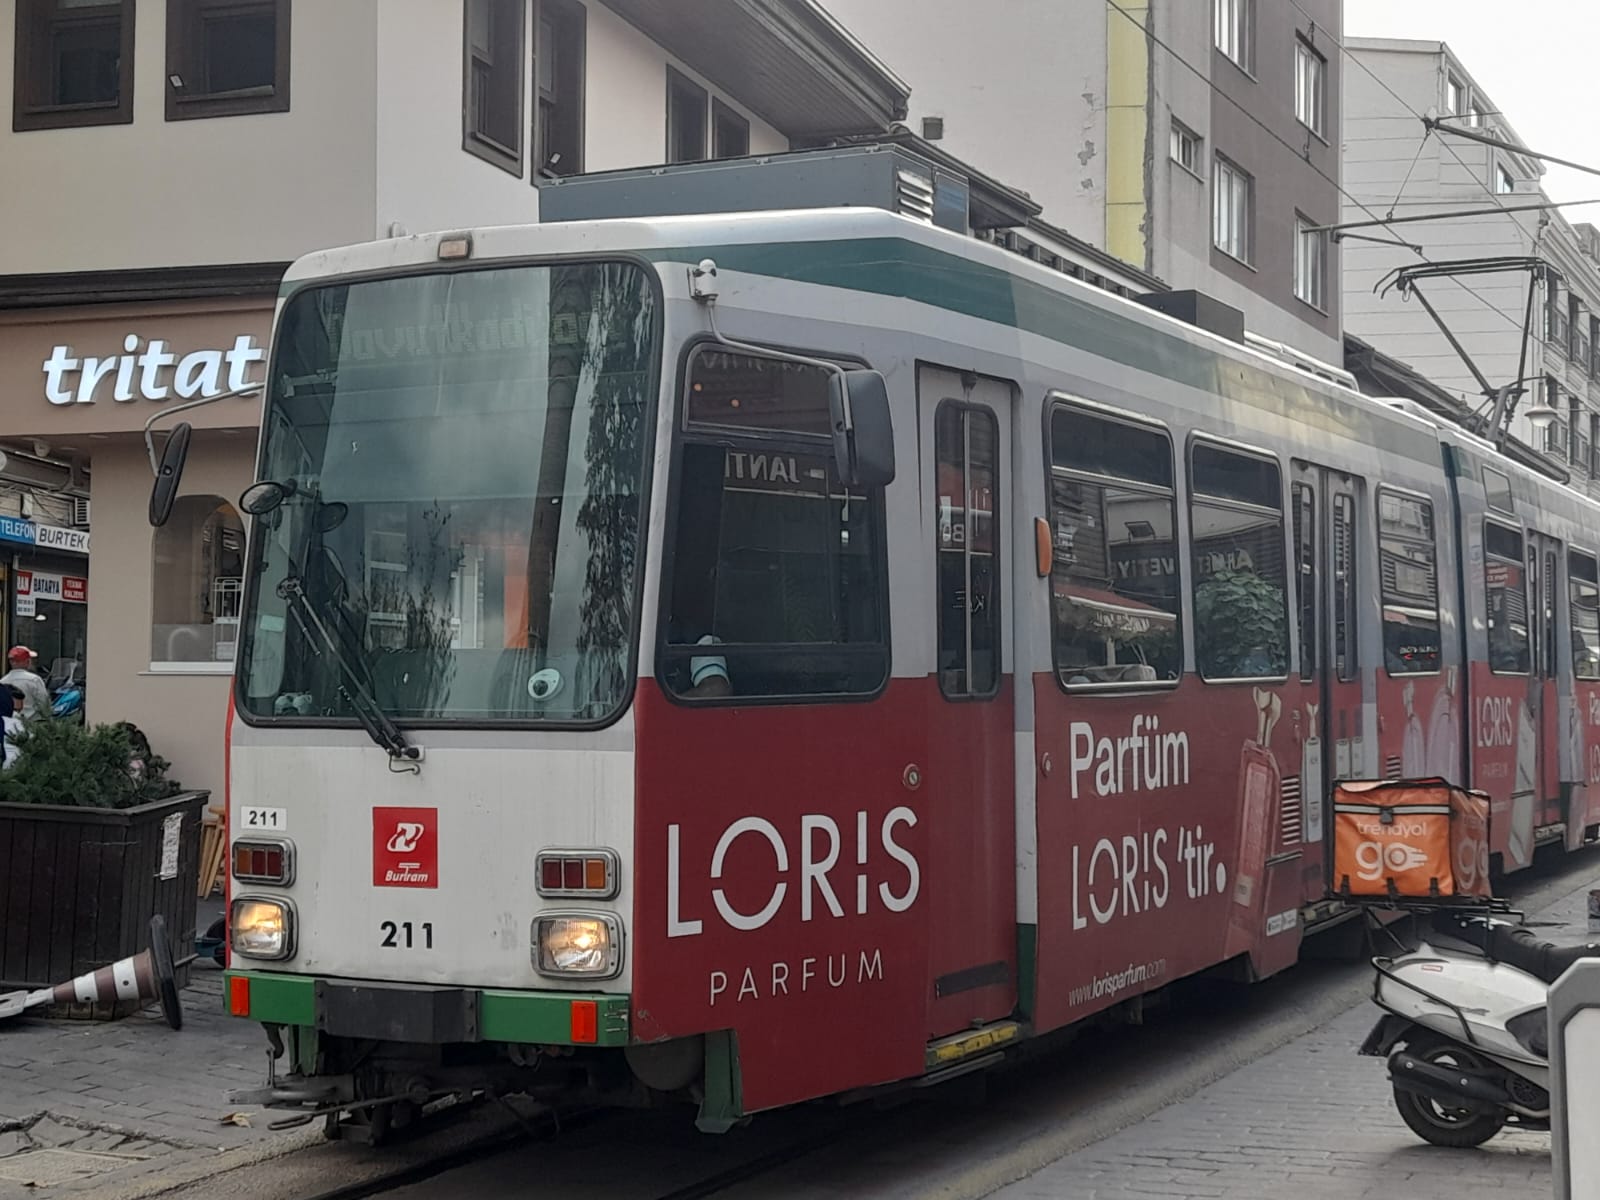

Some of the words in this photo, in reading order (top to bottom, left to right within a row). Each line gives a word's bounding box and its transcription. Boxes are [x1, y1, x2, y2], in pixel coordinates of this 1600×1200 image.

[42, 334, 266, 406] tritat
[0, 519, 36, 539] TELEFON
[39, 528, 85, 549] BURTEK
[33, 577, 60, 594] BATARYA
[1476, 696, 1512, 747] LORIS
[1070, 714, 1189, 799] Parfüm
[249, 810, 277, 826] 211
[1356, 821, 1427, 838] trendyol
[667, 806, 920, 938] LORIS
[1073, 828, 1169, 930] LORIS
[1355, 841, 1428, 881] go
[380, 921, 433, 949] 211
[710, 949, 883, 1006] PARFUM
[1069, 958, 1167, 1007] www.lorisparfum.com
